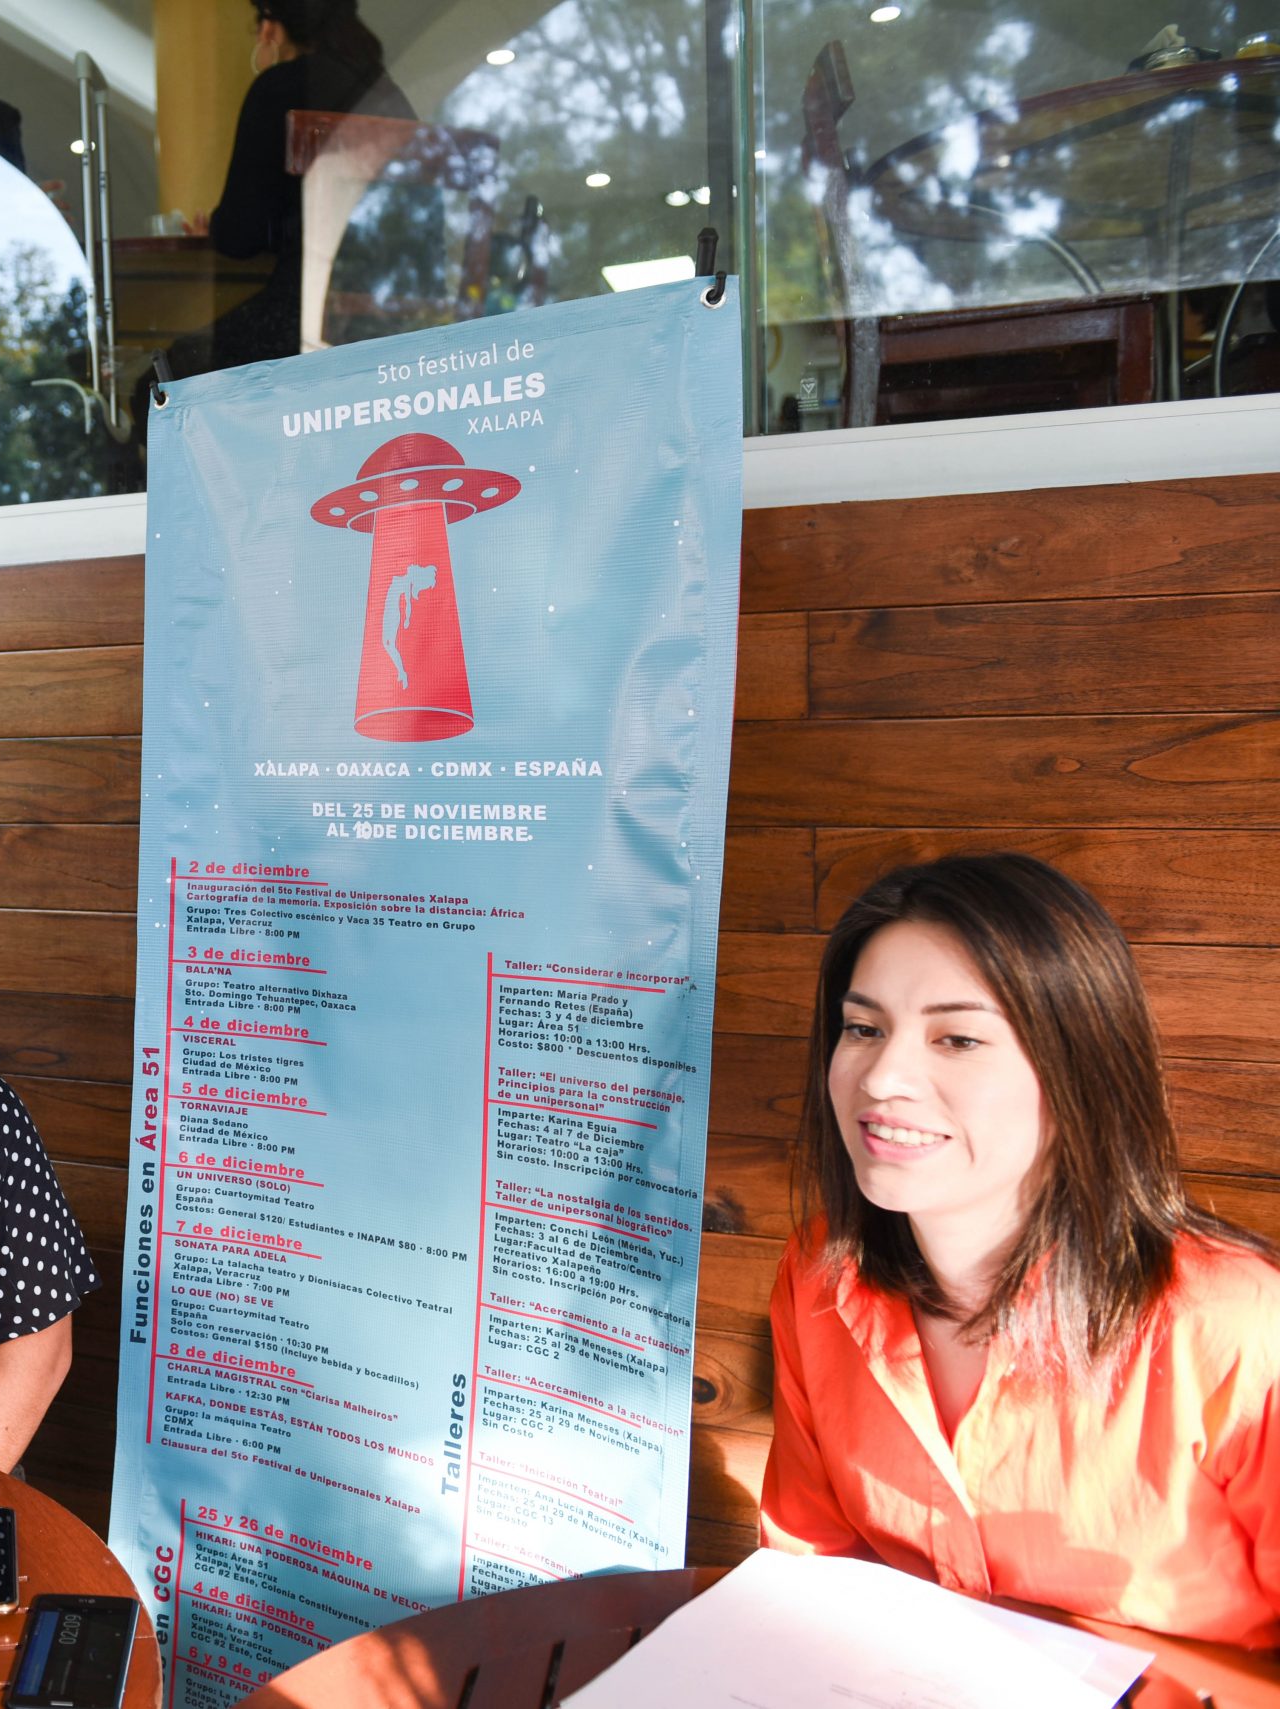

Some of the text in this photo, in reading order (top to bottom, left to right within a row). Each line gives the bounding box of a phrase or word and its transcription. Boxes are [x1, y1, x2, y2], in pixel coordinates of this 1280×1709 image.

[378, 340, 534, 384] 5to festival de
[283, 373, 545, 437] UNIPERSONALES
[468, 409, 543, 434] XALAPA
[337, 763, 409, 776] OAXACA
[431, 762, 491, 776] CDMX
[515, 758, 602, 776] ESPAÑA
[313, 802, 546, 820] DEL 25 DE NOVIEMBRE
[327, 823, 349, 837] AL
[373, 824, 396, 838] DE
[188, 861, 310, 877] 2 de diciembre
[186, 892, 524, 918] Cartografía de la memoria. Exposición sobre la distancia: África
[187, 883, 469, 905] Inauguración del 5to Festival de Unipersonales Xalapa
[186, 906, 220, 917] Grupo:
[224, 907, 246, 915] Tres
[249, 909, 293, 918] Colectivo
[295, 913, 335, 922] escénico
[337, 916, 343, 924] y
[346, 915, 369, 924] Vaca
[372, 917, 384, 925] 35
[387, 918, 422, 927] Teatro
[442, 921, 475, 931] Grupo
[186, 915, 272, 928] Xalapa, Veracruz
[186, 924, 300, 939] Entrada Libre 8:00 PM
[187, 946, 310, 966] 3 de diciembre
[185, 979, 219, 992] Grupo:
[224, 981, 255, 990] Teatro
[258, 984, 309, 995] alternativo
[184, 988, 356, 1011] Sto. Domingo Tehuantepec, Oaxaca
[183, 1015, 309, 1038] 4 de diciembre
[498, 1006, 644, 1029] Fechas: 3 y 4 de diciembre
[182, 1035, 236, 1046] VISCERAL
[498, 1027, 549, 1040] Horarios:
[553, 1033, 582, 1044] 10:00
[595, 1038, 624, 1049] 13:00
[627, 1042, 650, 1053] Hrs.
[182, 1082, 307, 1106] 5 de diciembre
[181, 1102, 248, 1115] TORNAVIAJE
[178, 1151, 305, 1178] 6 de diciembre
[176, 1170, 291, 1193] UN UNIVERSO (SOLO)
[130, 1048, 159, 1344] Funciones en Área 51
[175, 1202, 214, 1213] Costos:
[217, 1207, 256, 1219] General
[288, 1218, 345, 1236] Estudiantes
[357, 1232, 395, 1246] INAPAM
[398, 1240, 416, 1251] $80
[425, 1246, 448, 1257] 8:00
[451, 1251, 467, 1261] PM
[175, 1220, 302, 1249] 7 de diciembre
[174, 1239, 287, 1262] SONATA PARA ADELA
[170, 1285, 274, 1308] LO QUE (NO) SE VE
[487, 1335, 560, 1360] Lugar: CGC 2
[169, 1343, 296, 1377] 8 de diciembre
[165, 1391, 206, 1406] KAFKA,
[208, 1399, 246, 1413] DONDE
[325, 1427, 361, 1444] TODOS
[363, 1439, 384, 1451] LOS
[387, 1446, 435, 1466] MUNDOS
[441, 1374, 467, 1495] Talleres
[197, 1506, 373, 1568] 25 y 26 de noviembre
[154, 1546, 173, 1602] CGC
[192, 1582, 315, 1630] 4 de diciembre
[58, 1614, 82, 1645] 02:09
